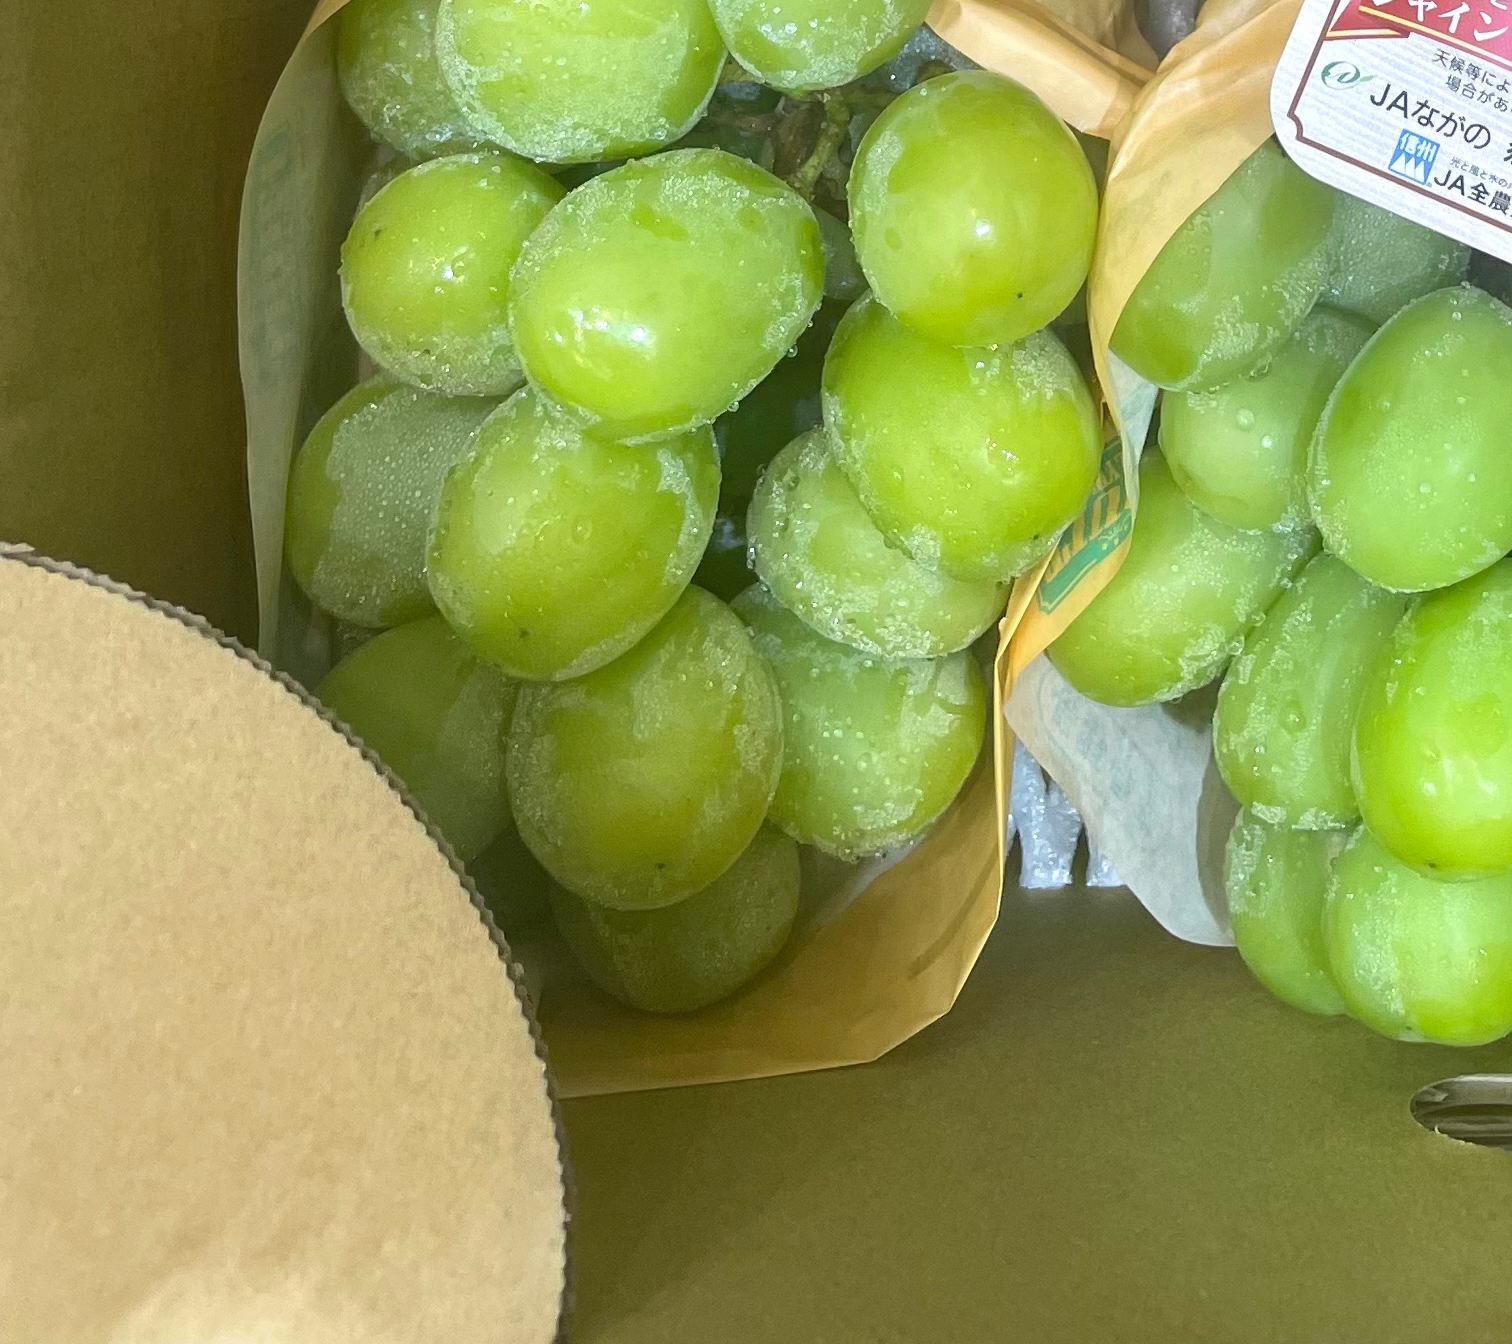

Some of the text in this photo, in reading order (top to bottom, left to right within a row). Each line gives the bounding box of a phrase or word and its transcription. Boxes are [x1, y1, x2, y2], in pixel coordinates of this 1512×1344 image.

[1370, 83, 1491, 150] JAながの
[1400, 133, 1436, 161] 信州
